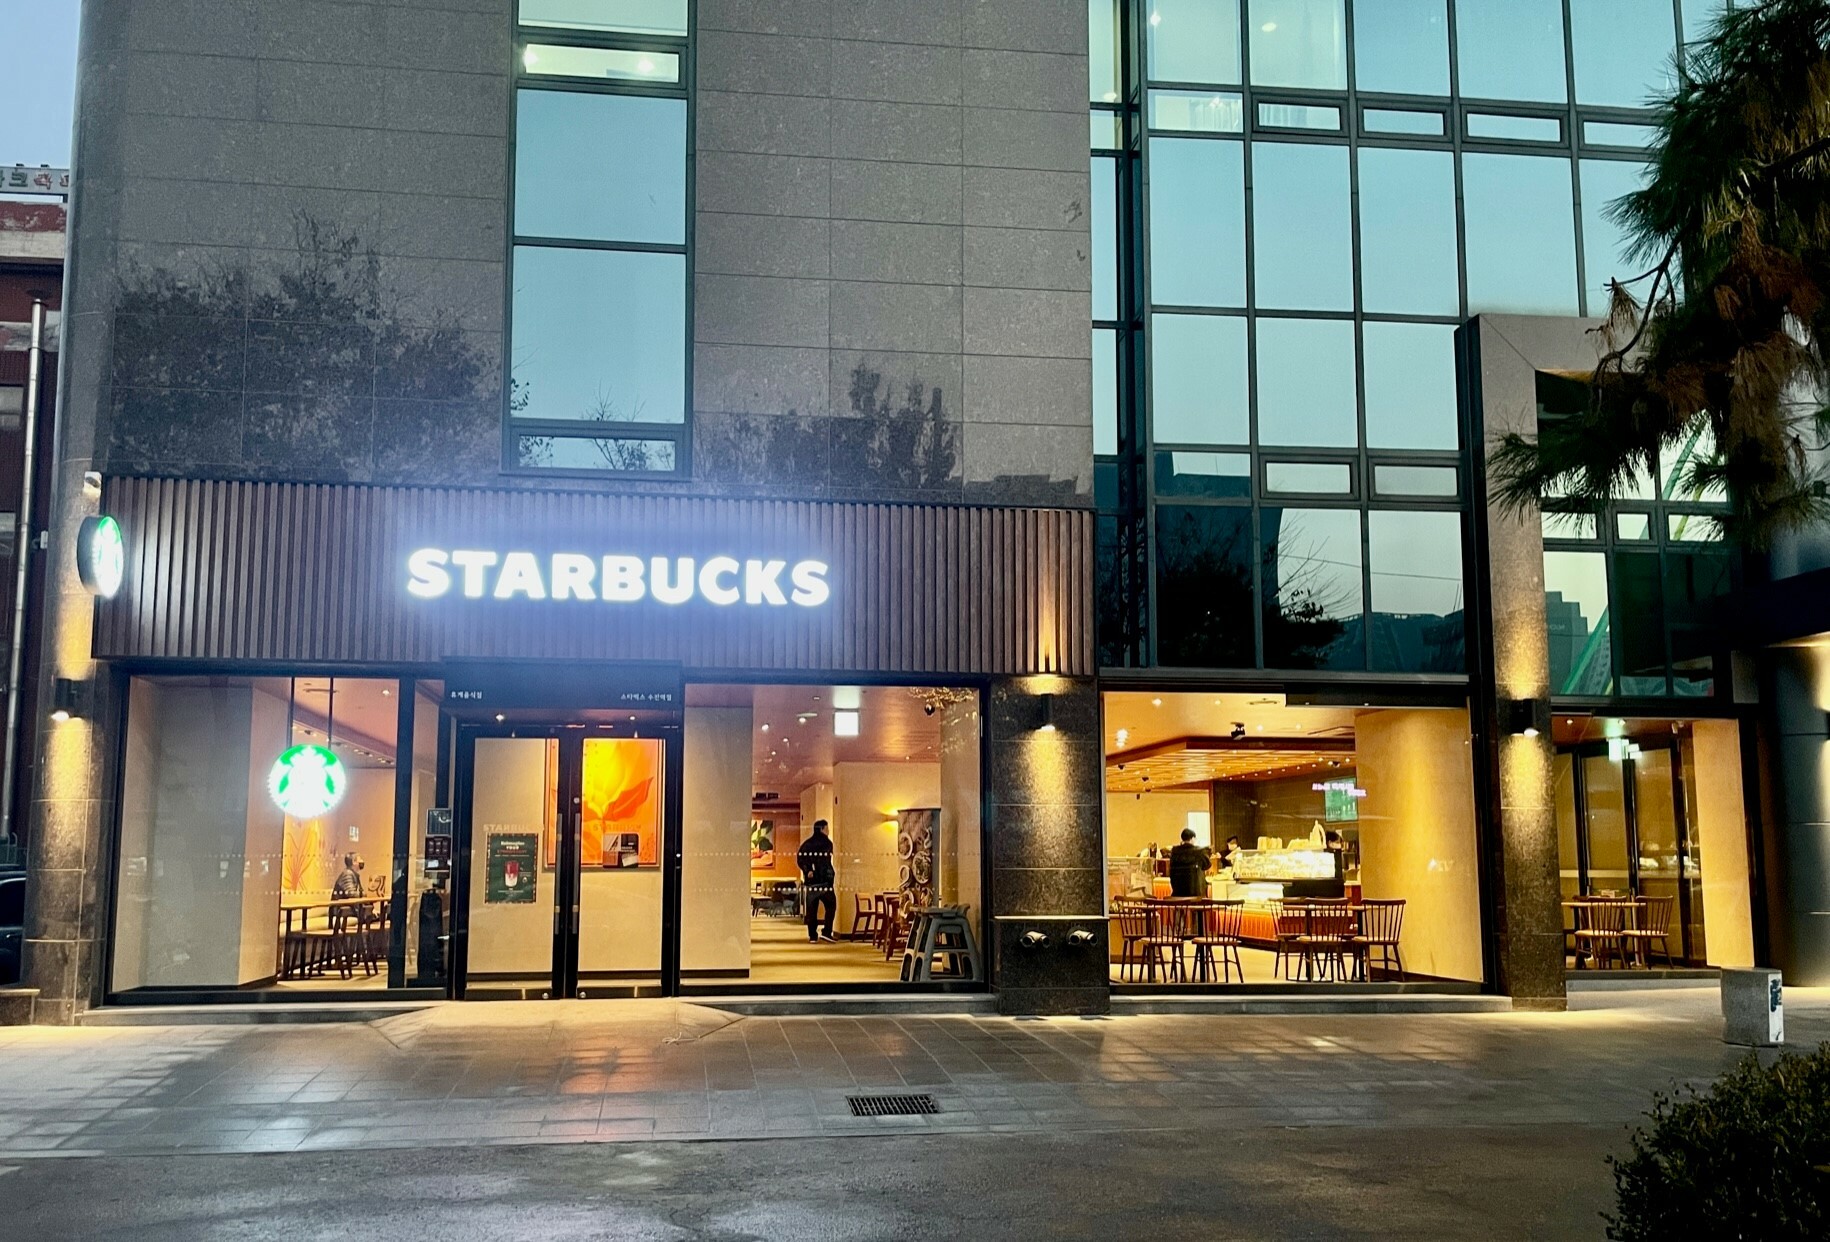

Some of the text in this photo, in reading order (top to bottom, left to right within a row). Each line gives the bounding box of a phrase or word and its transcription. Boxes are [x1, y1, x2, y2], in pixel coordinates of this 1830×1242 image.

[407, 548, 830, 606] STARBUCKS
[451, 691, 482, 699] 휴게음식점
[620, 693, 646, 701] 스타벅스
